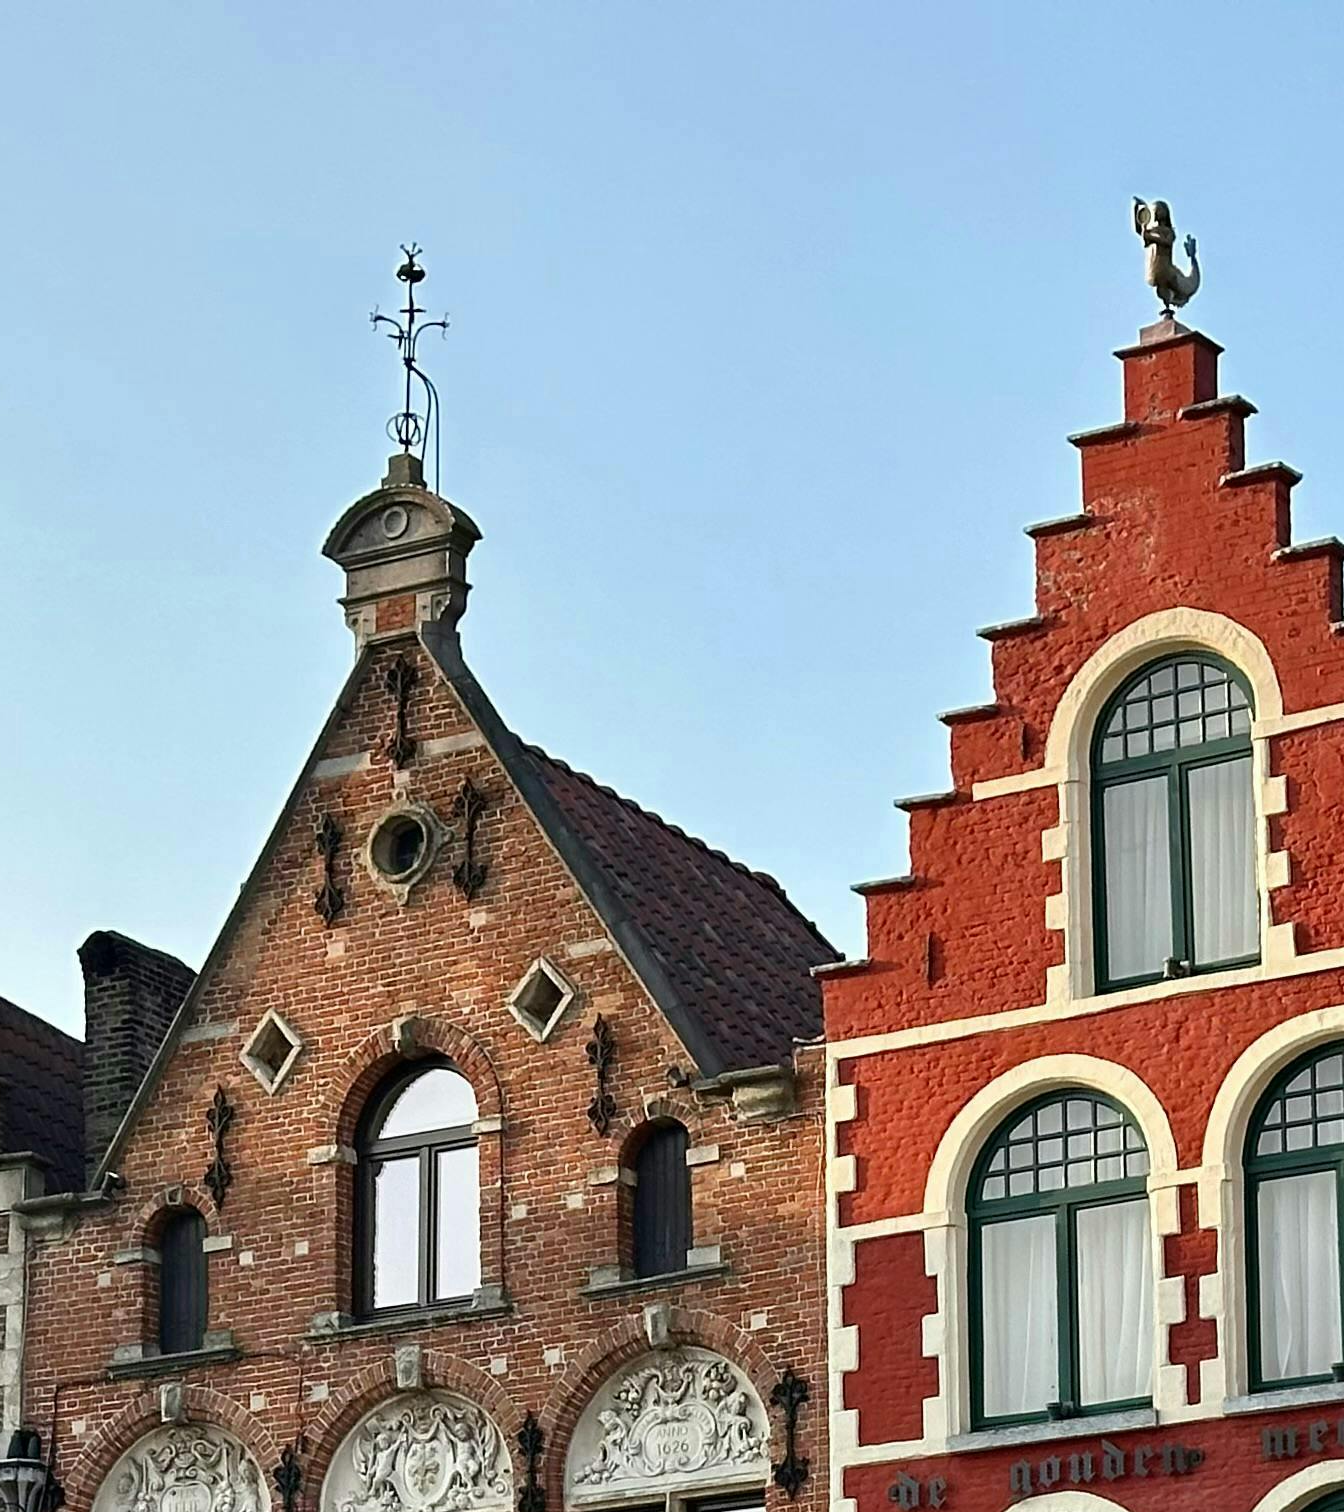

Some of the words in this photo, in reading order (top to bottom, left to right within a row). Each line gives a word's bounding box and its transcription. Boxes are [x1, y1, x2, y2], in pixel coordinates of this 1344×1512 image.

[657, 1440, 689, 1456] 1626
[894, 1469, 947, 1511] de
[1008, 1439, 1190, 1502] gouden
